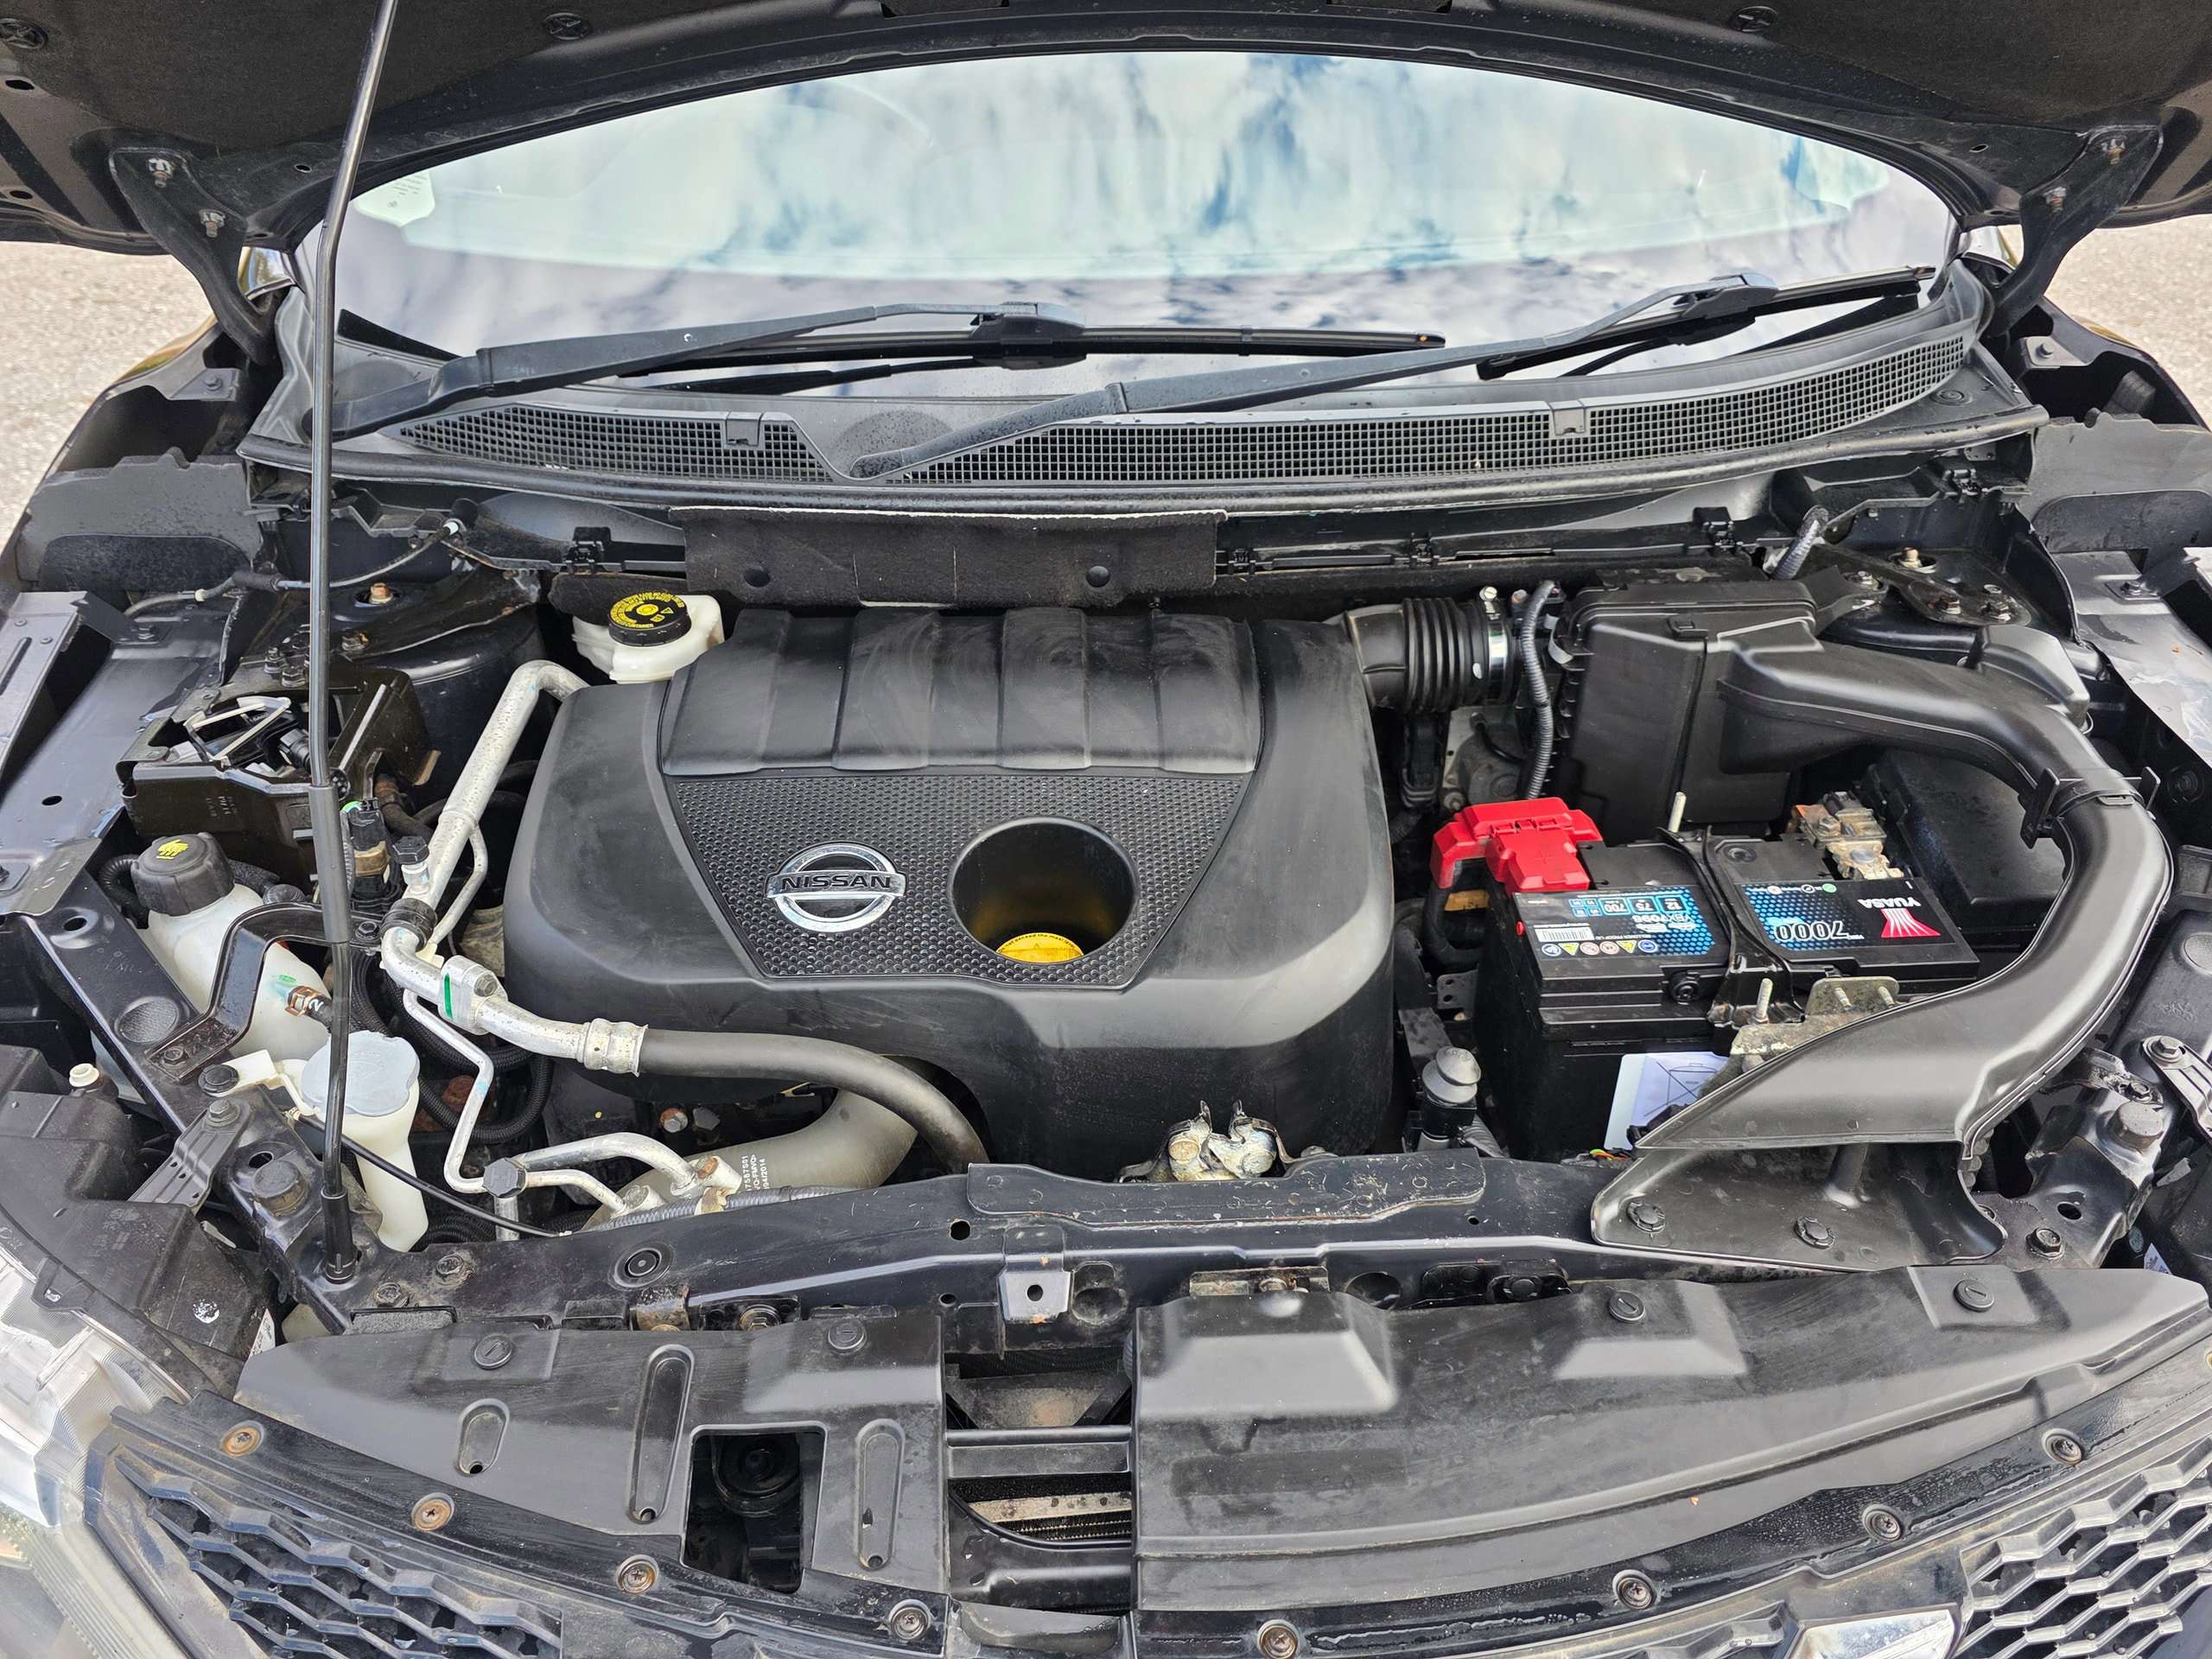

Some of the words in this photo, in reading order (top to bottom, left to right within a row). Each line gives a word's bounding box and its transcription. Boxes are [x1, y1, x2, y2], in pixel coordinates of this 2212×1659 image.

[781, 874, 891, 888] NISSAN
[1605, 902, 1626, 912] 700
[1635, 901, 1652, 911] 75
[1665, 901, 1682, 911] 12
[1857, 896, 1922, 909] YUASA
[1774, 920, 1848, 941] 7000
